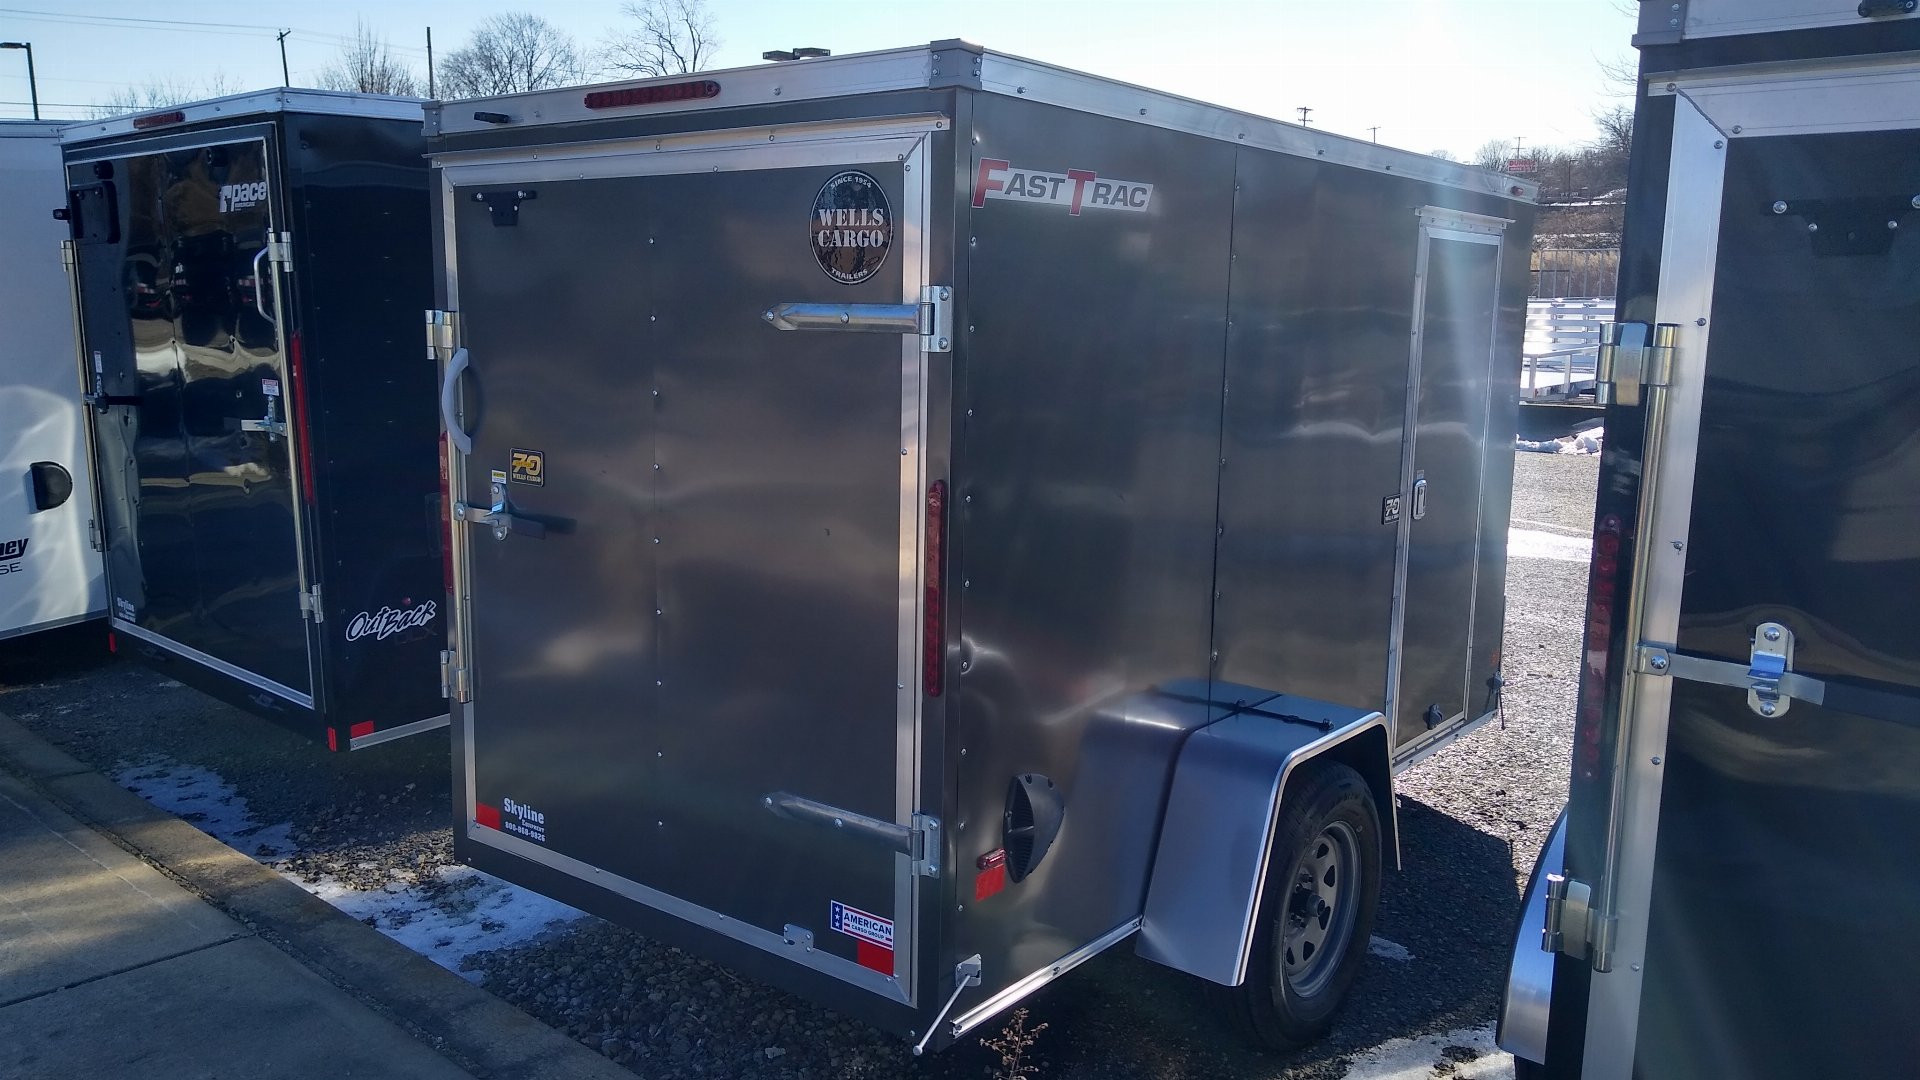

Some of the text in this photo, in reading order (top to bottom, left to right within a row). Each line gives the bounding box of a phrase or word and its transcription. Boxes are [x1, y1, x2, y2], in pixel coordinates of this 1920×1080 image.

[830, 176, 872, 190] SINCE 1954
[231, 181, 267, 212] pace
[818, 208, 884, 226] WELLS
[817, 229, 884, 248] CARGO
[831, 267, 868, 280] TRAILERS
[512, 452, 541, 476] 70
[503, 797, 545, 825] Skyline
[843, 912, 892, 936] AMERICAN
[851, 924, 885, 940] CARGO GROUP
